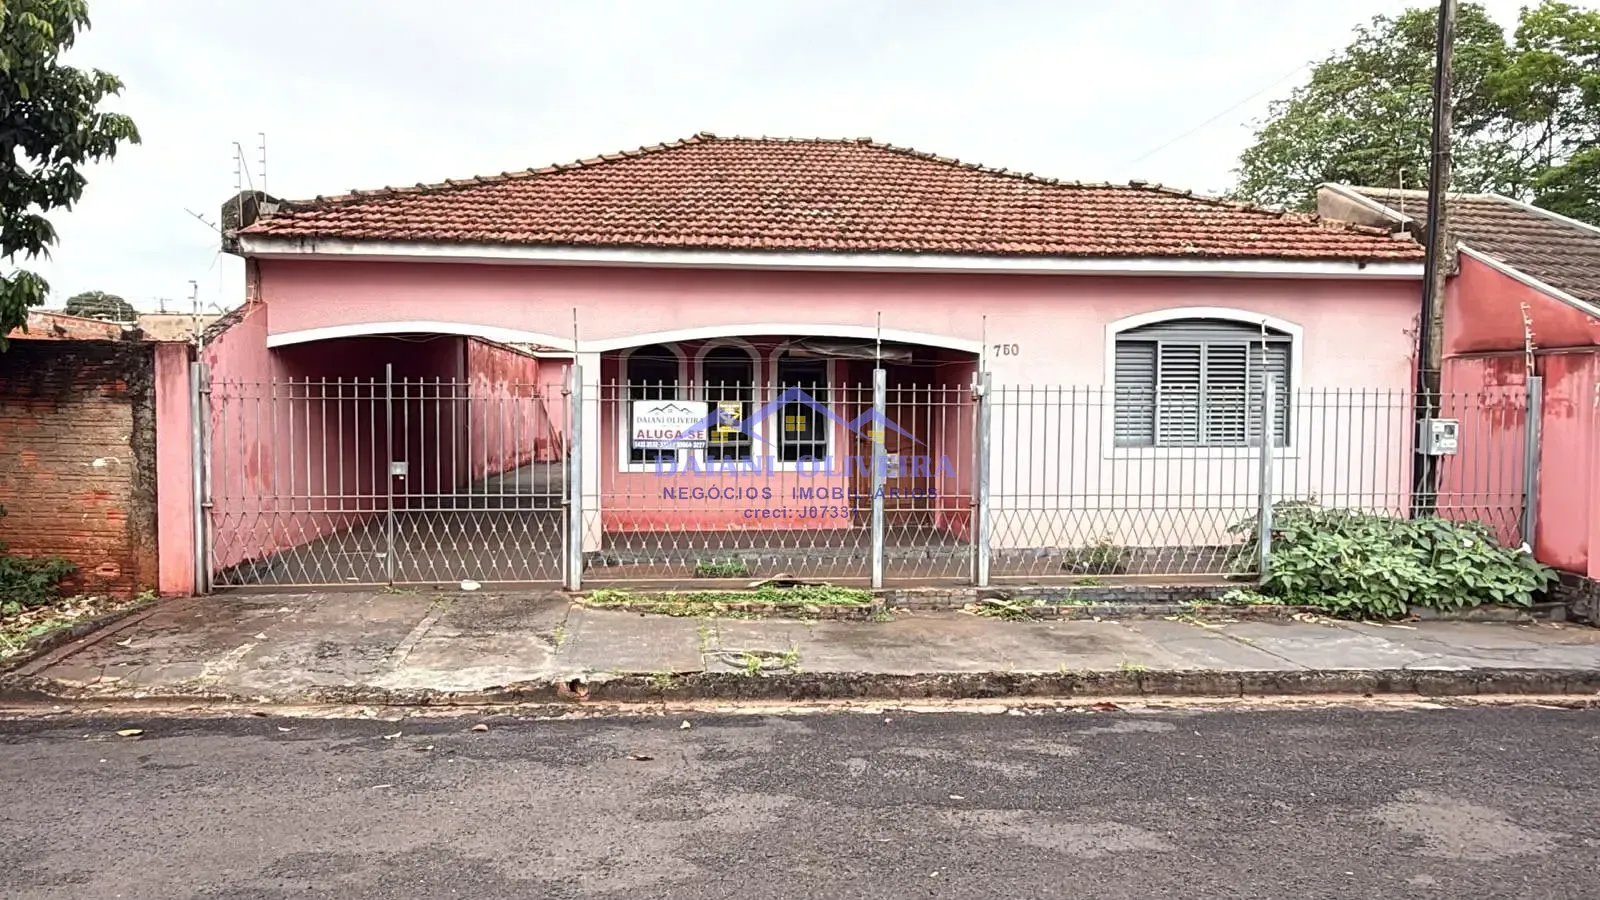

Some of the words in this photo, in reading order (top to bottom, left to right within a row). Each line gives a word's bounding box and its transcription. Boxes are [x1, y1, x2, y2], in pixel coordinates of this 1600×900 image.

[993, 343, 1020, 358] 750
[636, 416, 665, 424] DAIANI
[668, 416, 704, 425] OLIVEIRA
[636, 429, 683, 439] ALUGA
[687, 430, 705, 439] SE
